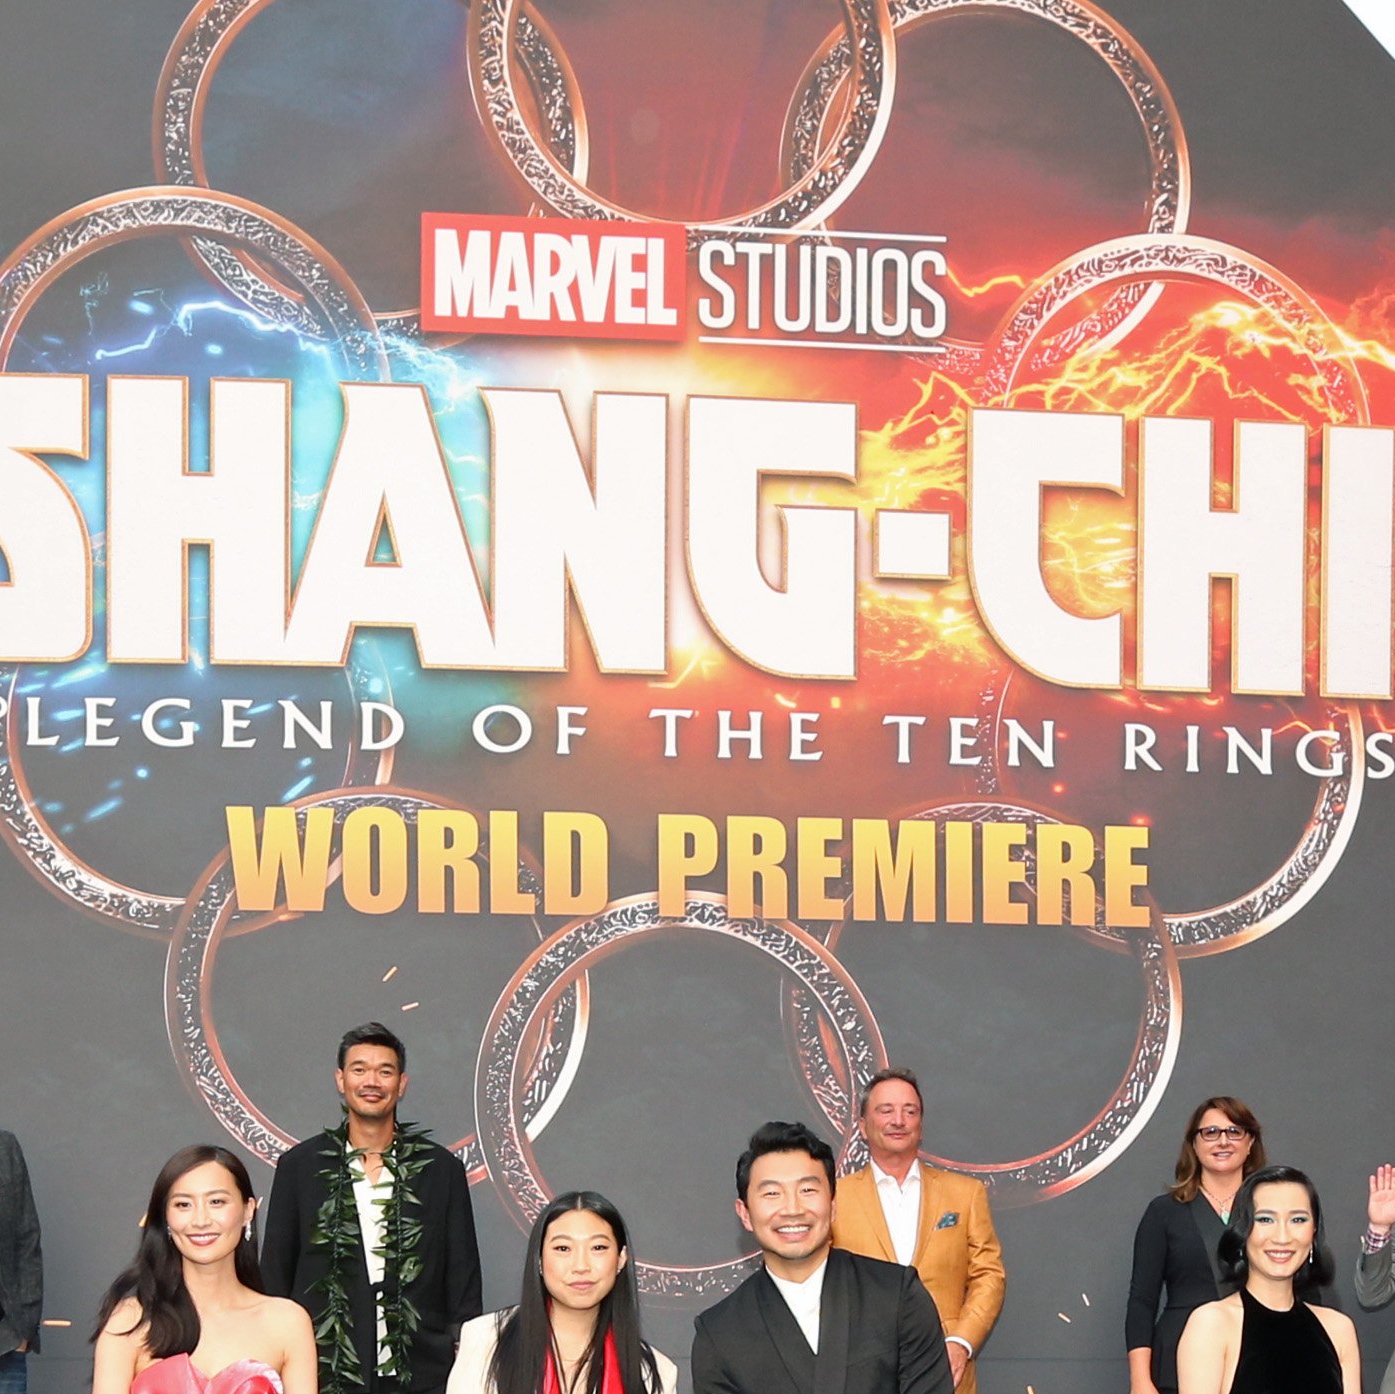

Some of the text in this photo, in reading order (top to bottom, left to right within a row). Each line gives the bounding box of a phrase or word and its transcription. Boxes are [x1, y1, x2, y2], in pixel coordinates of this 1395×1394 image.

[434, 228, 947, 338] MARVEL STUDIOS
[26, 696, 1395, 779] LEGEND OF THE TEN RINGS
[225, 805, 1151, 928] WORLD PREMIERE
